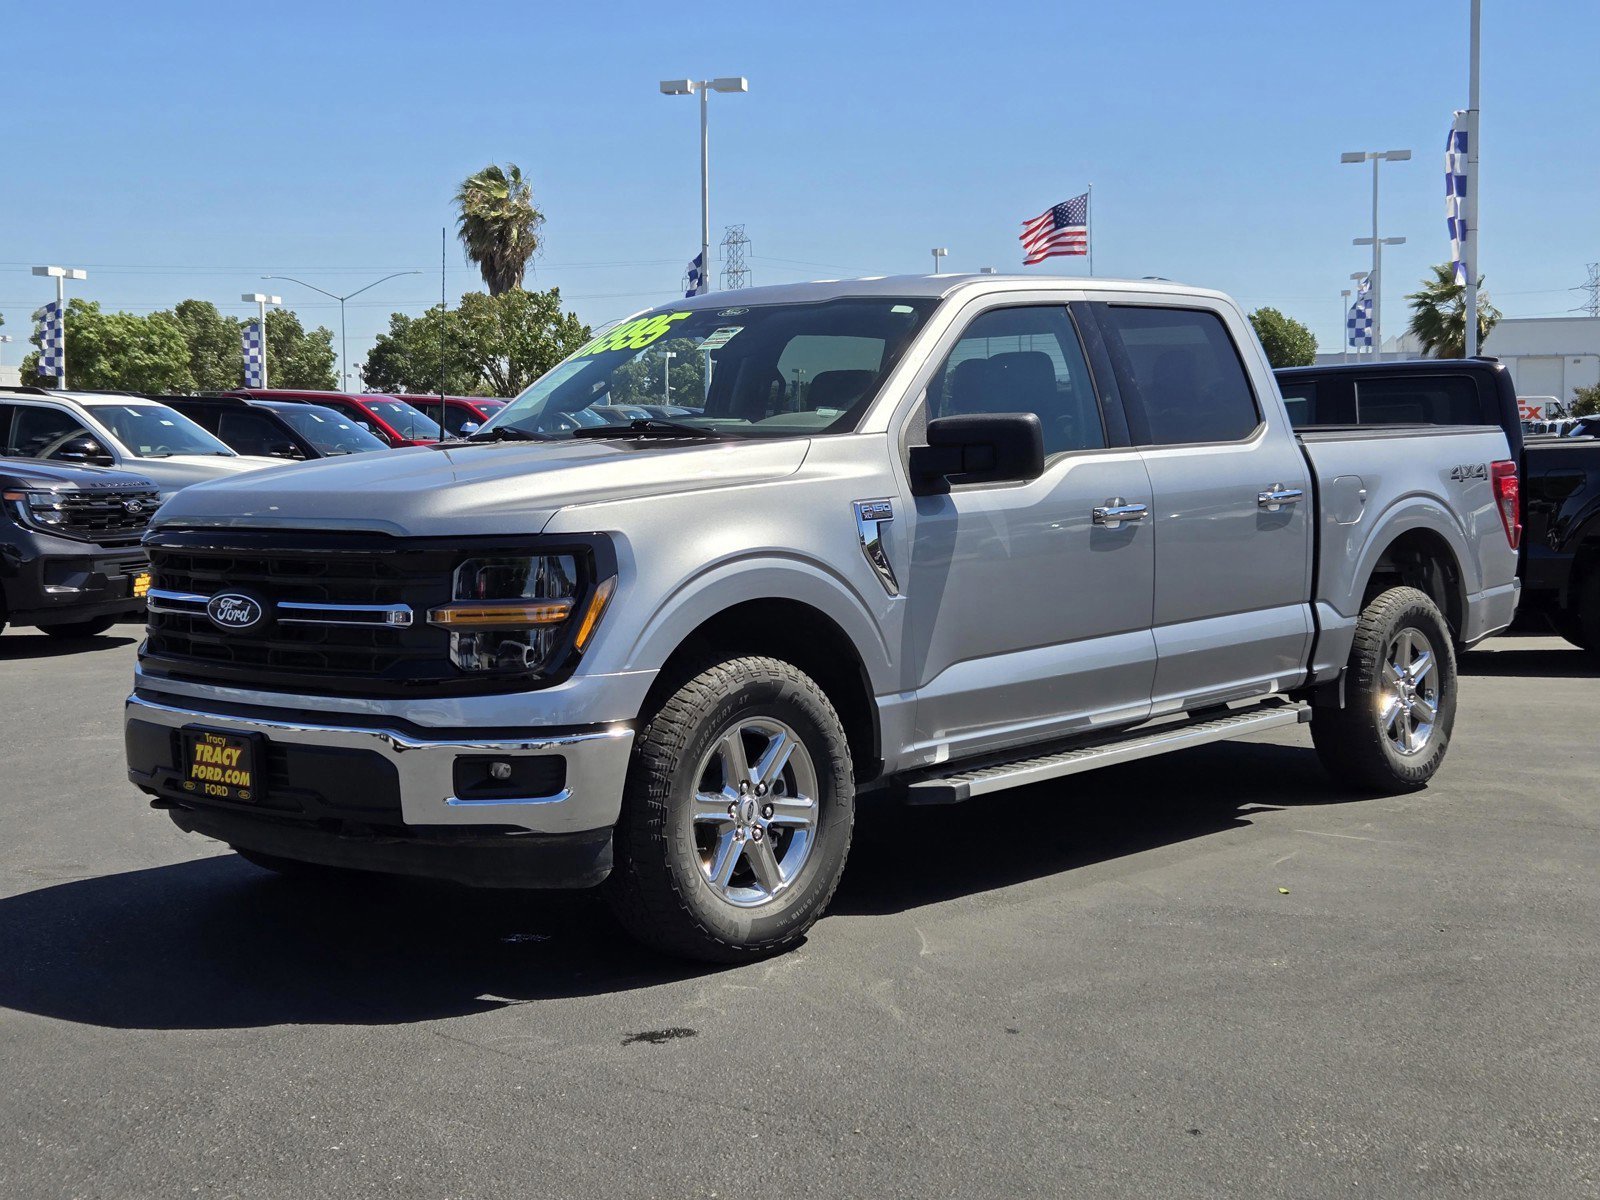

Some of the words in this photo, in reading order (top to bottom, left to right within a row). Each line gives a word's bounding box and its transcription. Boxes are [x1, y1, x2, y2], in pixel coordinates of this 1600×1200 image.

[217, 597, 251, 622] Ford
[205, 733, 226, 747] Tracy
[195, 744, 242, 767] TRACY
[191, 764, 251, 787] FORD.COM
[205, 783, 229, 797] FORD
